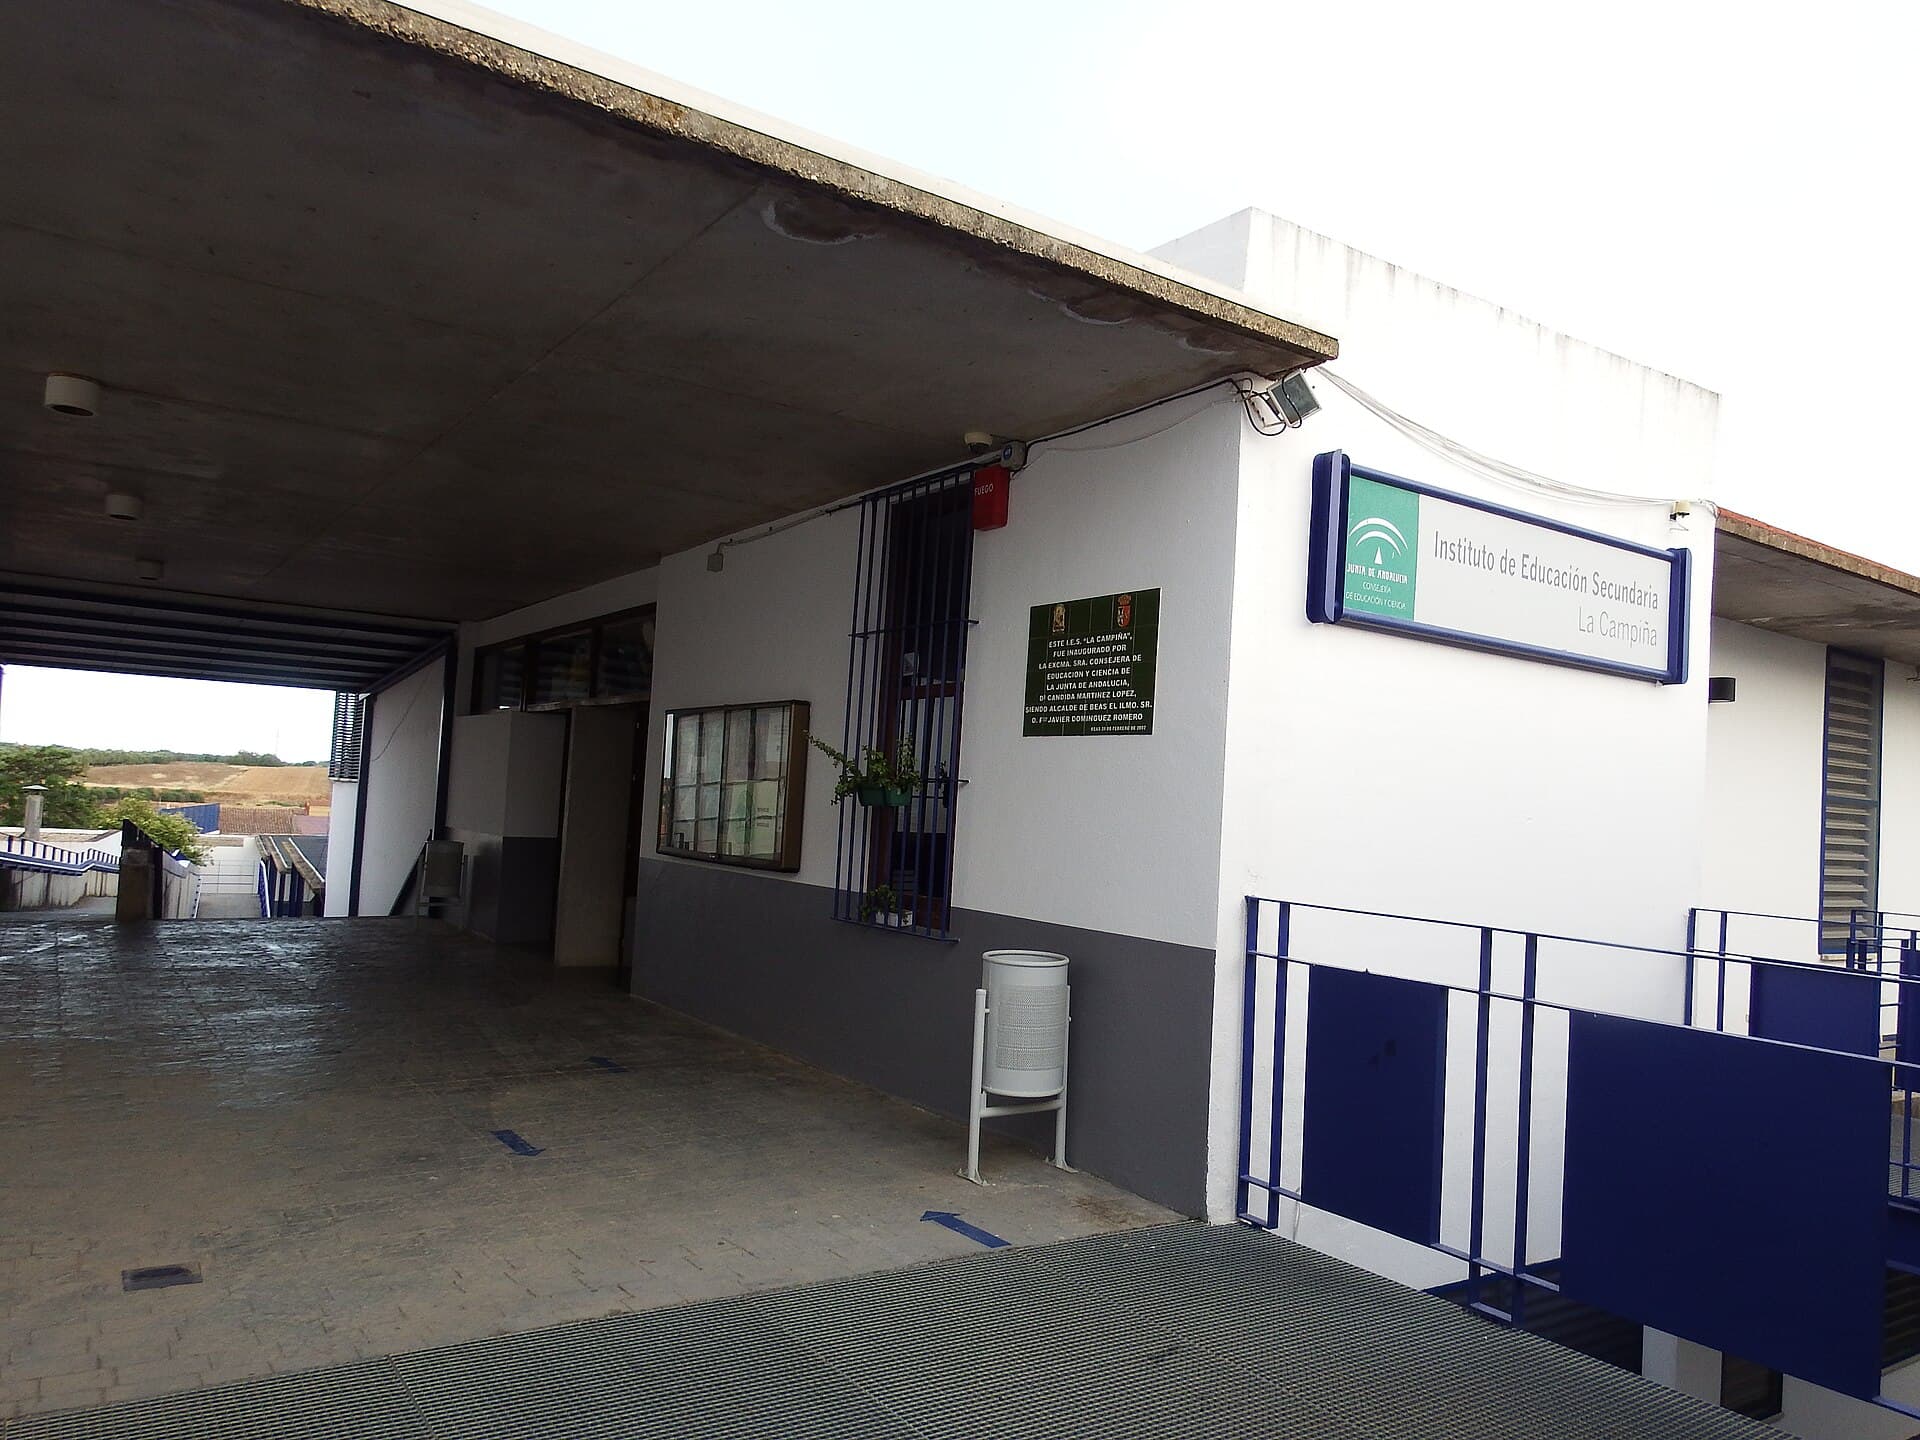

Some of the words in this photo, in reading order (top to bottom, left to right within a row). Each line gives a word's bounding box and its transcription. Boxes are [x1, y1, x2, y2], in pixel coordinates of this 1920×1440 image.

[974, 483, 994, 496] FUEGO
[1346, 563, 1366, 576] JUNTA
[1368, 567, 1376, 578] DE
[1434, 530, 1495, 571] Instituto
[1499, 548, 1517, 577] de
[1521, 553, 1588, 594] Educación
[1591, 571, 1659, 610] Secundaria
[1345, 591, 1353, 600] DE
[1578, 605, 1594, 634] La
[1599, 610, 1657, 649] Campiña
[1048, 639, 1065, 648] ESTE
[1066, 645, 1110, 657] INAUGURADO
[1112, 644, 1127, 652] POR
[1038, 662, 1047, 670] LA
[1048, 661, 1071, 669] EXCMA.
[1073, 659, 1088, 667] SRA.
[1089, 655, 1130, 665] CONSEJERA
[1132, 654, 1142, 662] DE
[1091, 668, 1119, 677] CIENCIA
[1121, 666, 1131, 675] DE
[1046, 683, 1055, 691] LA
[1056, 682, 1077, 690] JUNTA
[1078, 681, 1087, 689] DE
[1025, 705, 1048, 713] SIENDO
[1048, 703, 1078, 713] ALCALDE
[1079, 703, 1088, 711] DE
[1089, 702, 1108, 711] BEAS
[1109, 702, 1118, 710] EL
[1119, 701, 1139, 710] ILMO.
[1140, 700, 1153, 708] SR.
[1047, 715, 1070, 723] JAVIER
[1113, 712, 1143, 722] ROMERO
